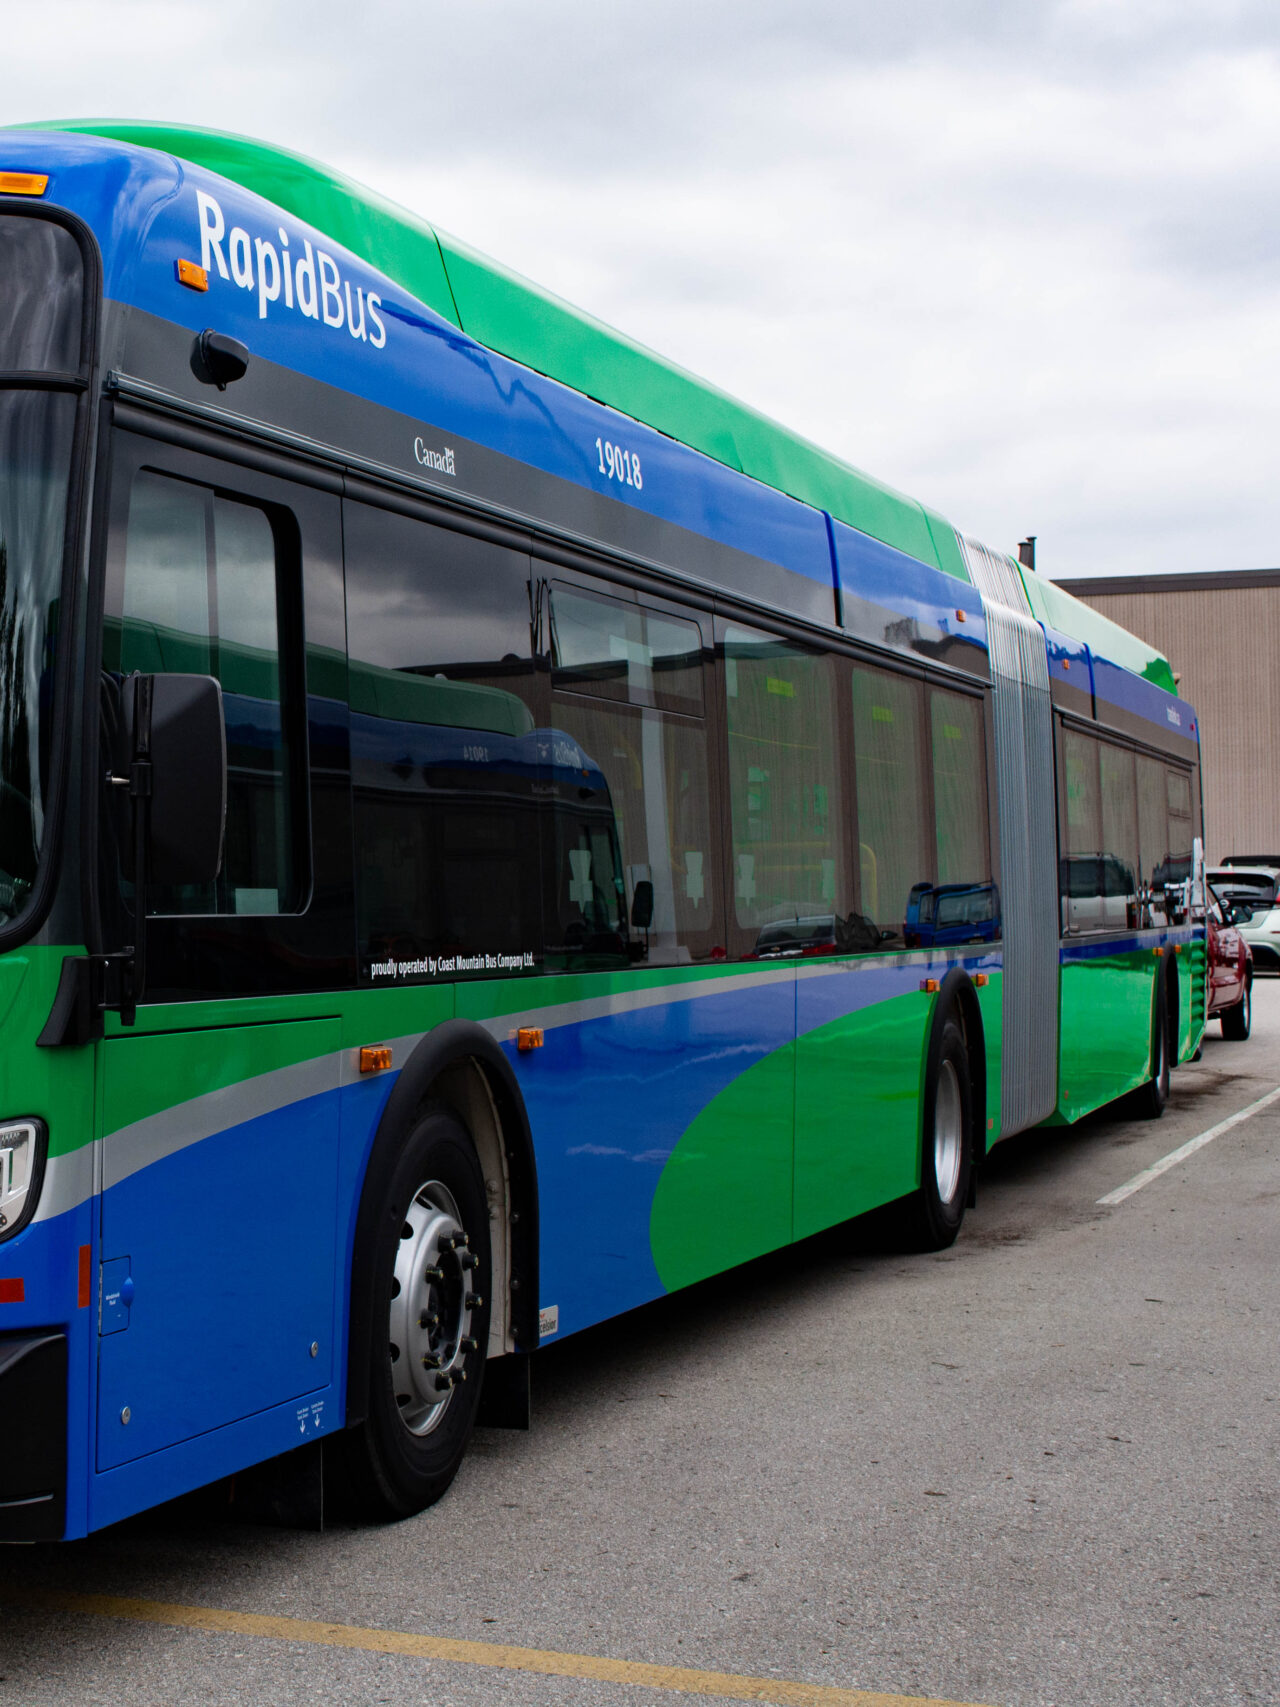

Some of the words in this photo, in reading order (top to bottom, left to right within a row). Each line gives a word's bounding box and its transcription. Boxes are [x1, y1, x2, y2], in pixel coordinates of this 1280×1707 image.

[196, 190, 386, 349] RapidBus
[414, 436, 456, 476] Canada
[595, 437, 643, 490] 19018
[371, 958, 398, 980] proudly
[399, 956, 428, 978] operated
[429, 956, 437, 976] by
[438, 956, 456, 972] Coast
[456, 953, 485, 970] Mountain
[485, 953, 497, 969] Bus
[497, 952, 524, 971] Company
[524, 951, 535, 967] Ltd.
